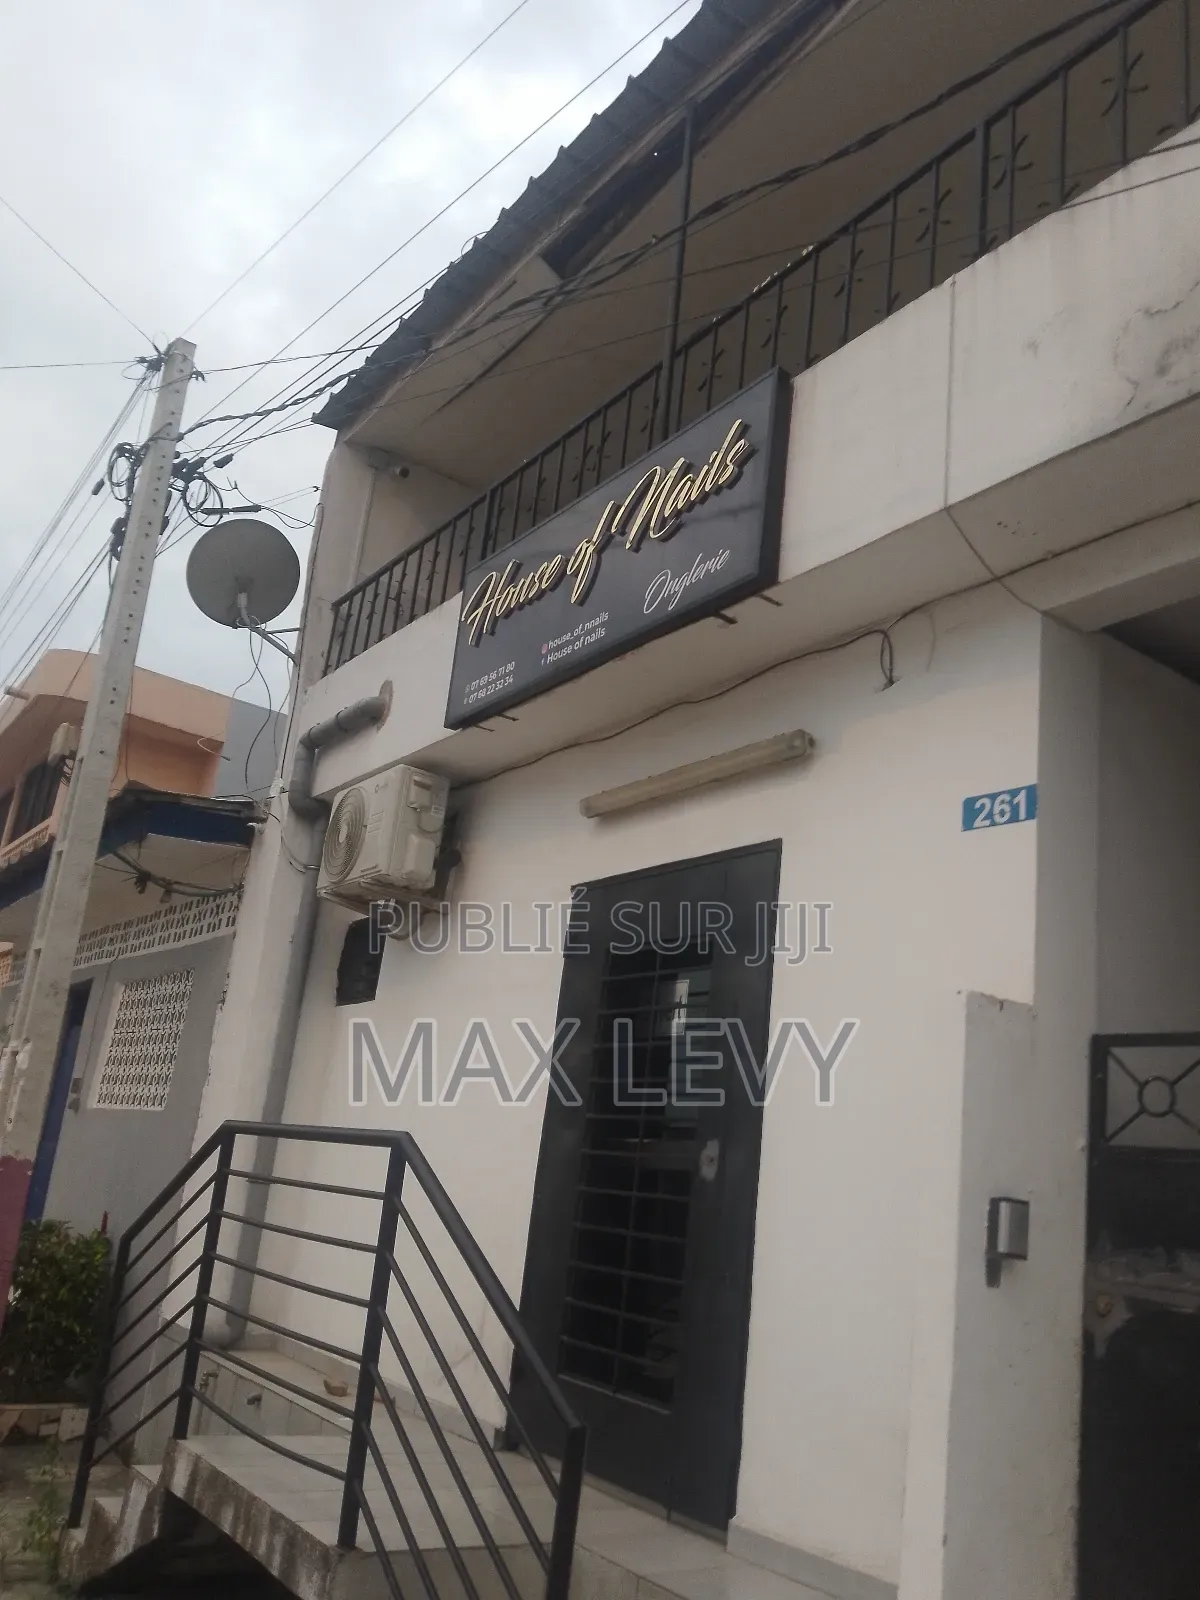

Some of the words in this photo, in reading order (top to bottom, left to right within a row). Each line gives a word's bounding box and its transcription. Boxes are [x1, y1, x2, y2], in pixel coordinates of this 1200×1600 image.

[461, 558, 564, 645] House
[566, 500, 616, 604] of
[612, 418, 750, 549] Nails
[644, 549, 730, 614] Onglerie
[547, 645, 573, 664] House
[574, 636, 584, 650] of
[584, 628, 606, 645] nails
[548, 611, 609, 650] house_of_nnails
[469, 692, 477, 703] 07
[487, 683, 495, 695] 22
[495, 679, 504, 690] 32
[504, 674, 514, 686] 34
[471, 679, 479, 691] 07
[506, 661, 515, 672] 80
[973, 789, 1027, 828] 261
